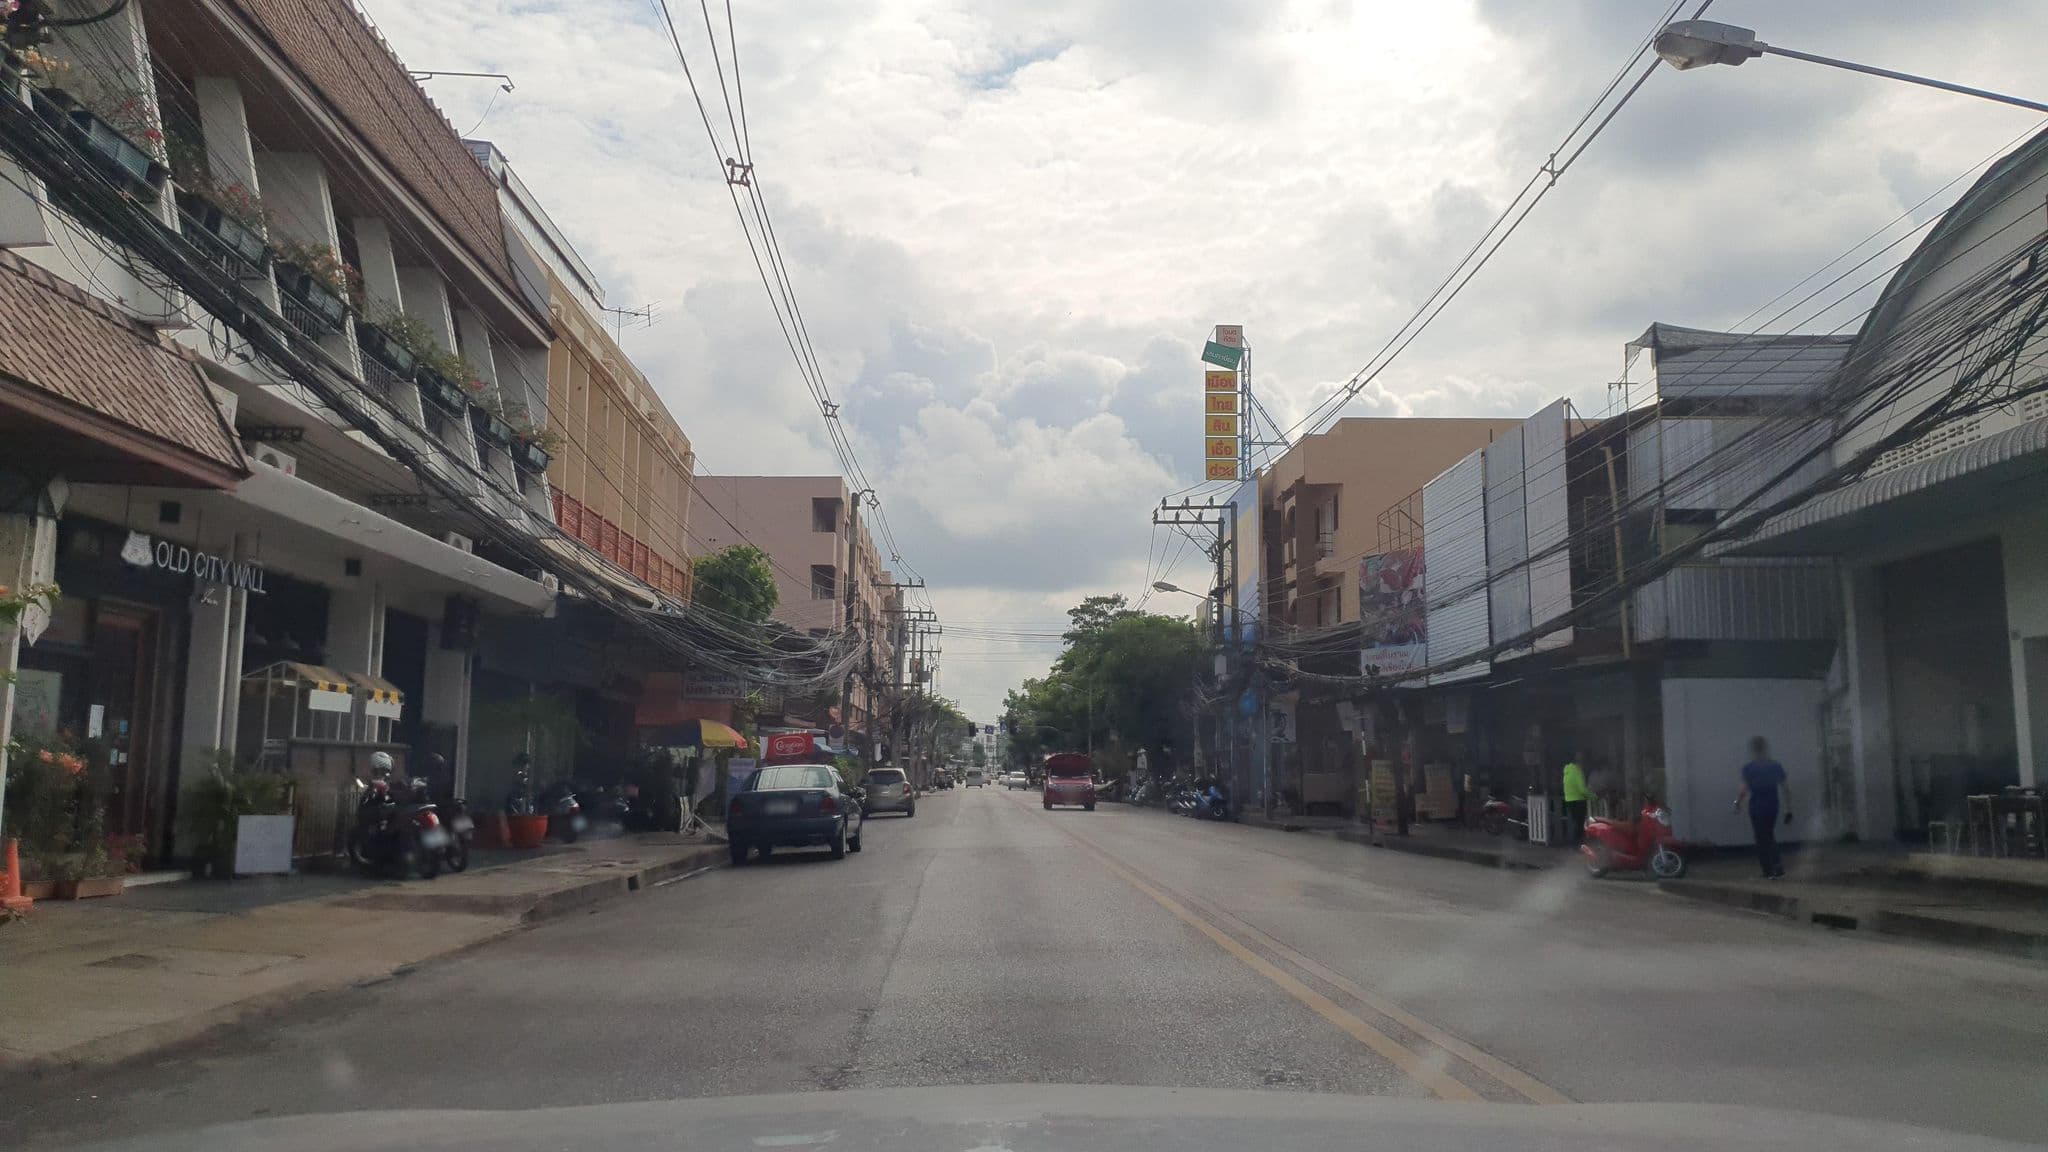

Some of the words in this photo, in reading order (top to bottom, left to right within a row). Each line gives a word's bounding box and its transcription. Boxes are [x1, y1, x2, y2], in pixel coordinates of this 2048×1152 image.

[1210, 396, 1233, 411] ไทย
[156, 540, 190, 573] OLD
[194, 551, 229, 584] CITY
[233, 561, 267, 594] WALL
